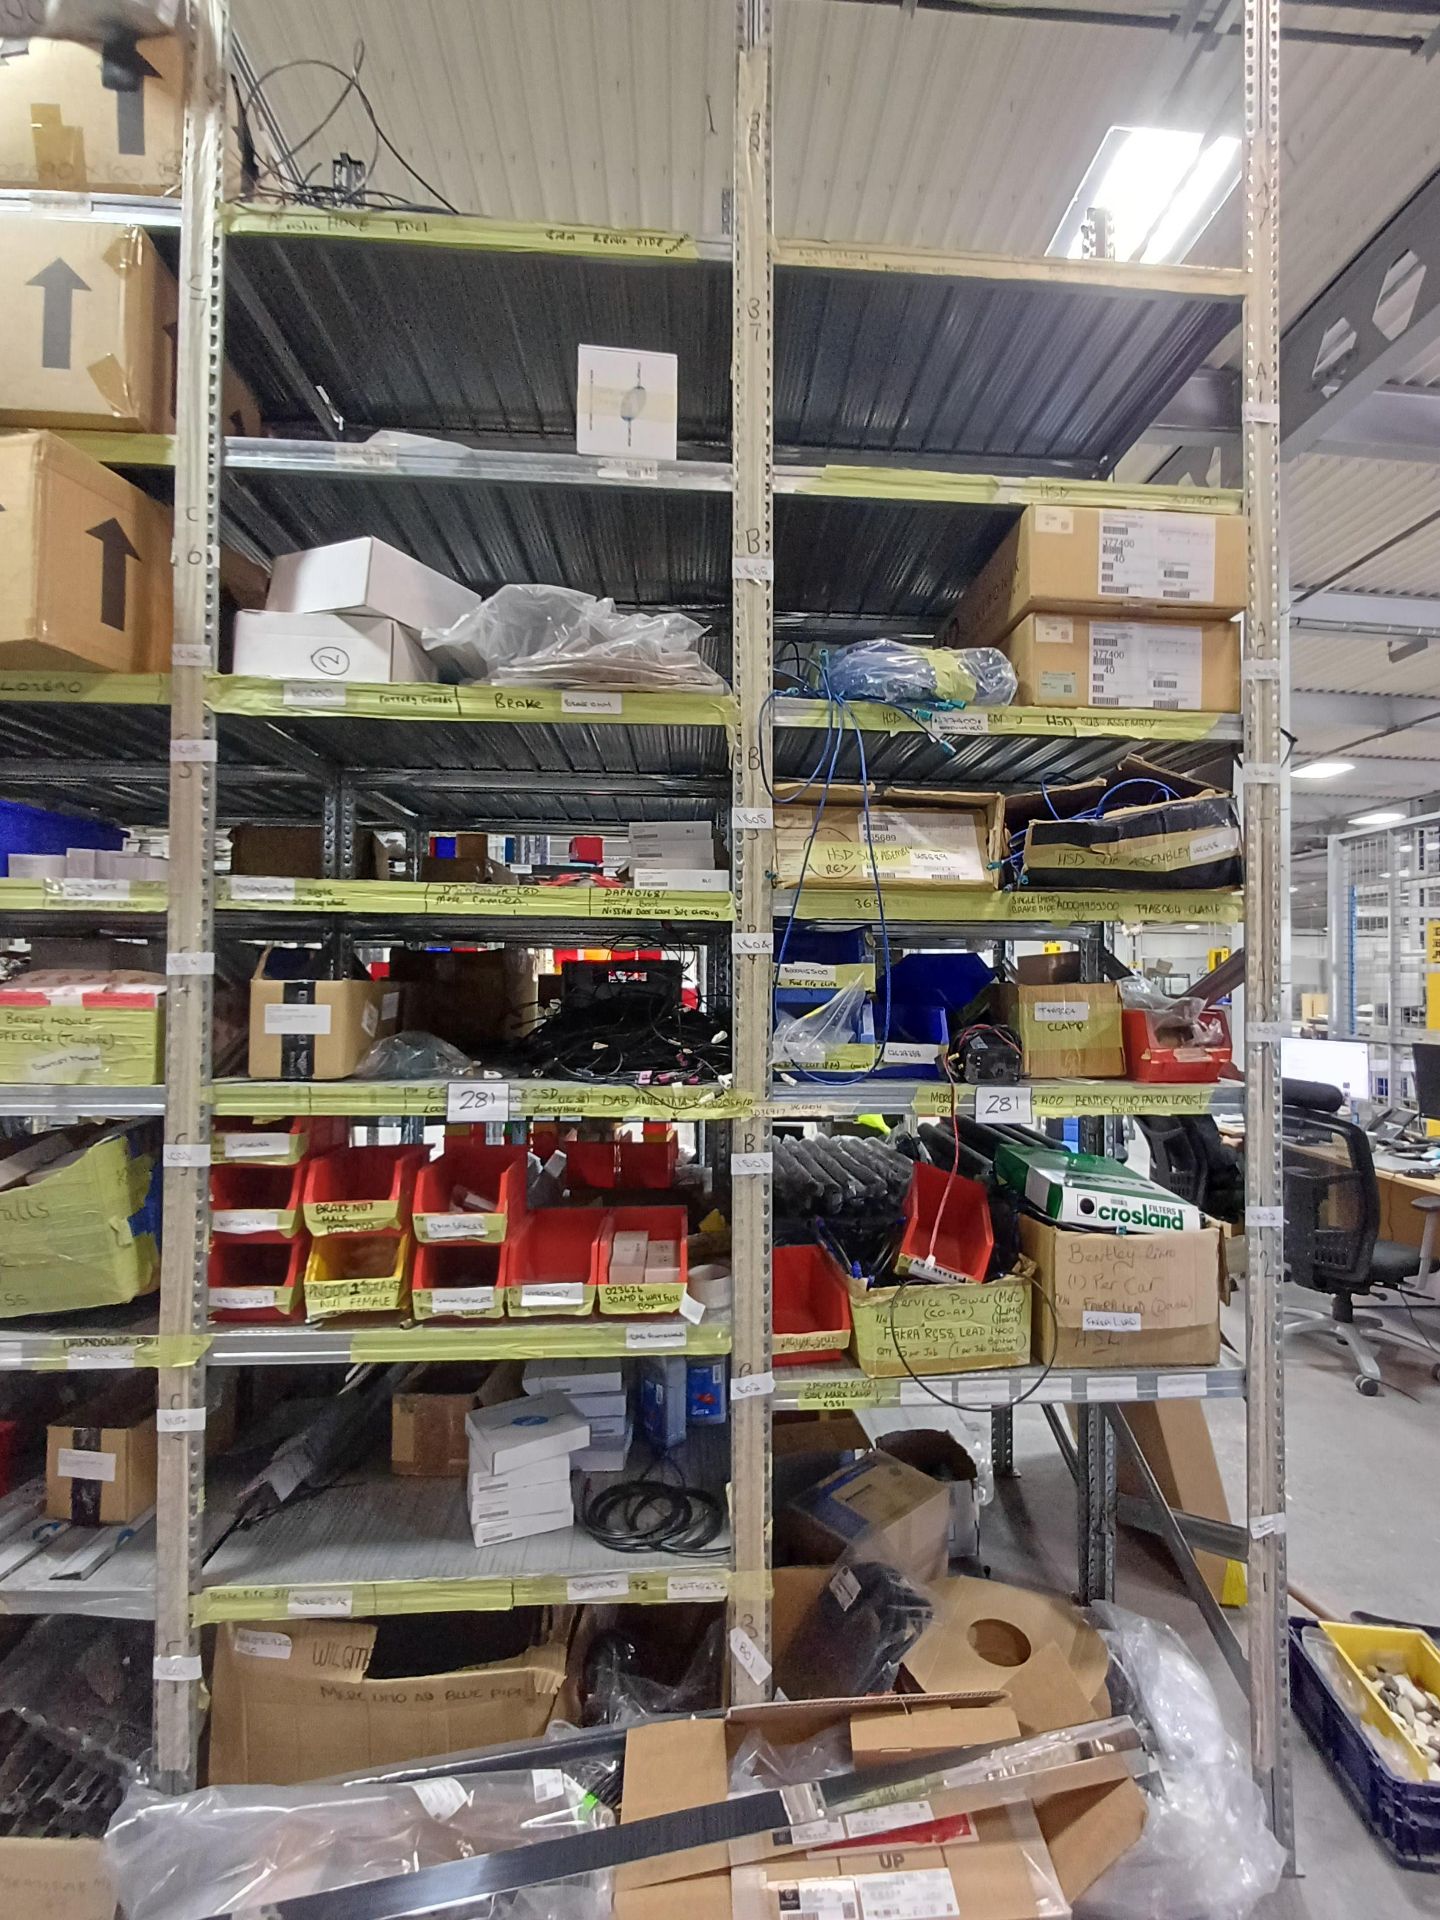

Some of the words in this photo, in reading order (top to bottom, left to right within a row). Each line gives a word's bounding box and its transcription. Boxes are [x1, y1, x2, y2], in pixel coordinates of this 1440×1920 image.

[1102, 538, 1135, 549] 377400
[1113, 554, 1125, 564] 40
[1093, 650, 1125, 660] 377400
[1104, 665, 1115, 675] 40
[1047, 1022, 1084, 1033] CLAMP
[985, 1094, 1020, 1115] 281
[1148, 1204, 1177, 1216] FILTERS
[1098, 1203, 1185, 1231] crosland
[878, 1853, 905, 1869] UP
